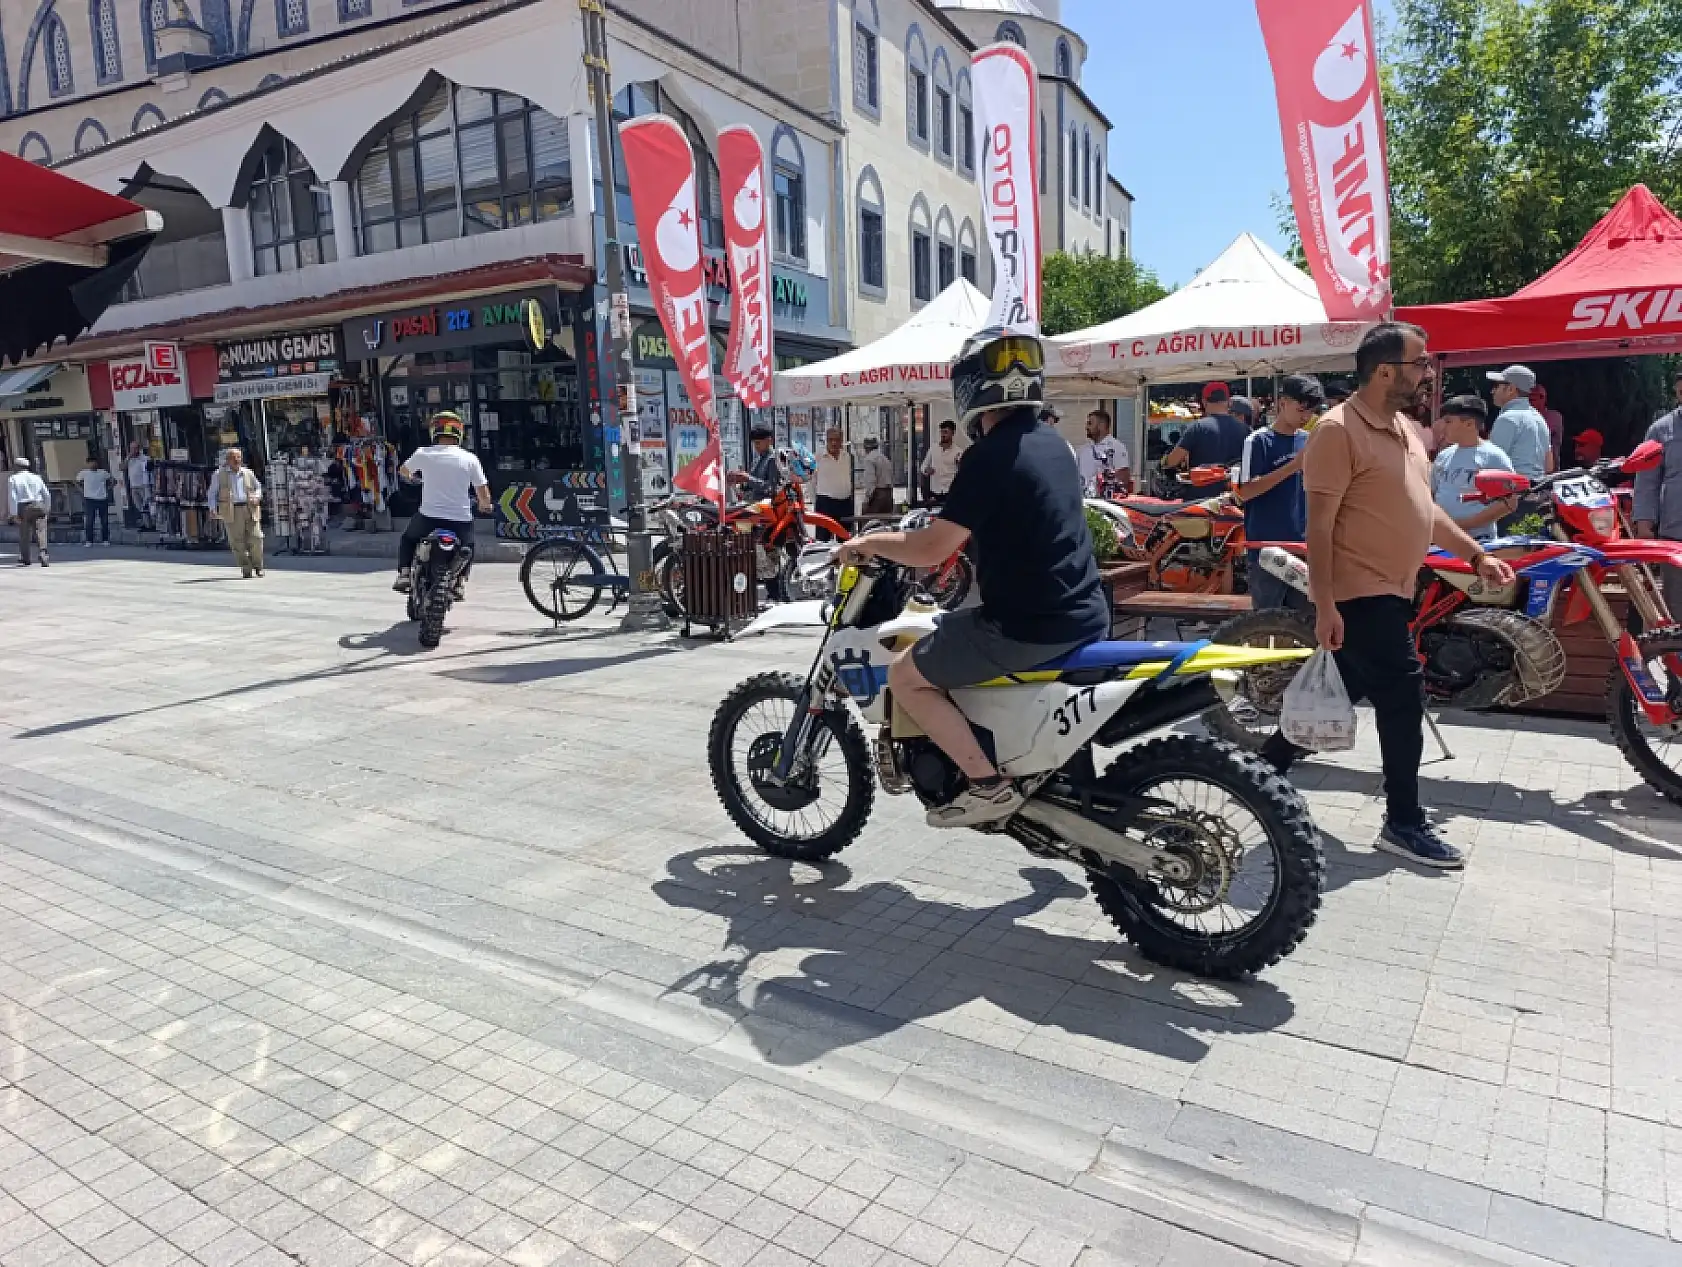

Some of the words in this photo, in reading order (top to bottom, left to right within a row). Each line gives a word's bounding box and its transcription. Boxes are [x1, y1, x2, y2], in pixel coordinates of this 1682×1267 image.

[446, 309, 473, 331] 212
[229, 341, 278, 366] NUHUN
[1053, 686, 1098, 736] 377
